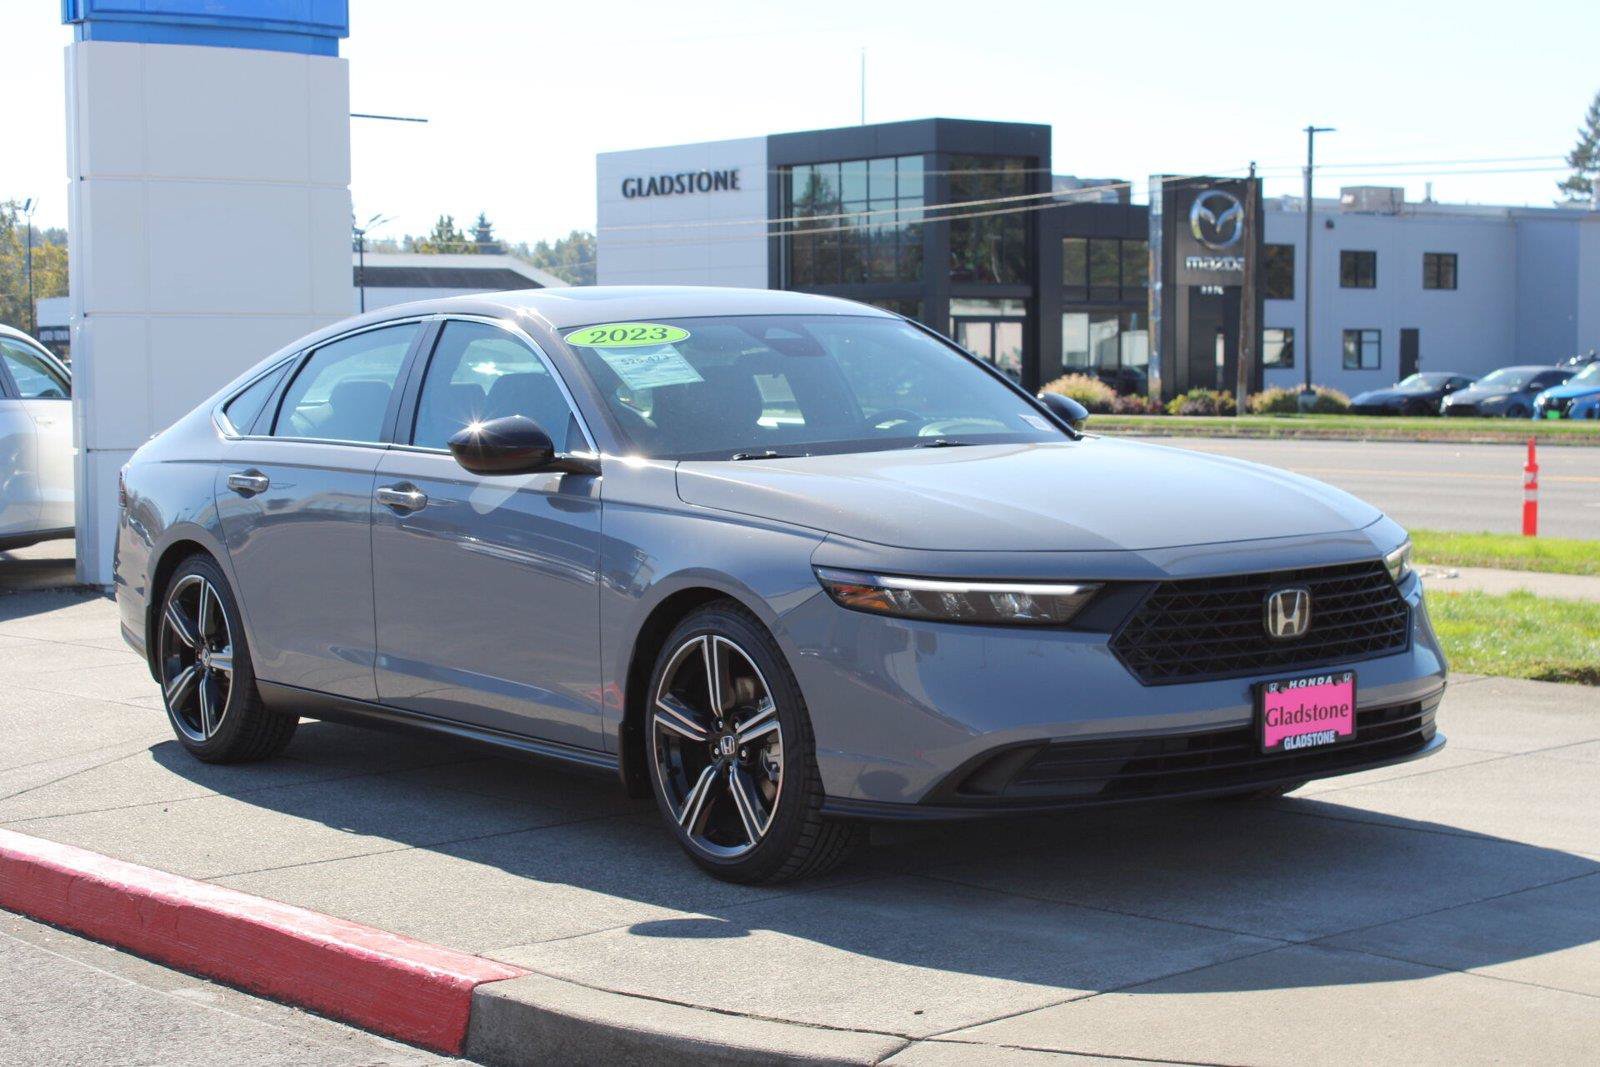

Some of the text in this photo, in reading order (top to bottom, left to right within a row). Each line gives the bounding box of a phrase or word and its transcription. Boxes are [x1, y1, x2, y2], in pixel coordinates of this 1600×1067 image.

[622, 169, 741, 199] GLADSTONE
[589, 326, 669, 345] 2023
[1288, 675, 1333, 690] HONDA
[1265, 702, 1350, 728] Gladstone
[1283, 730, 1337, 751] GLADSTONE
